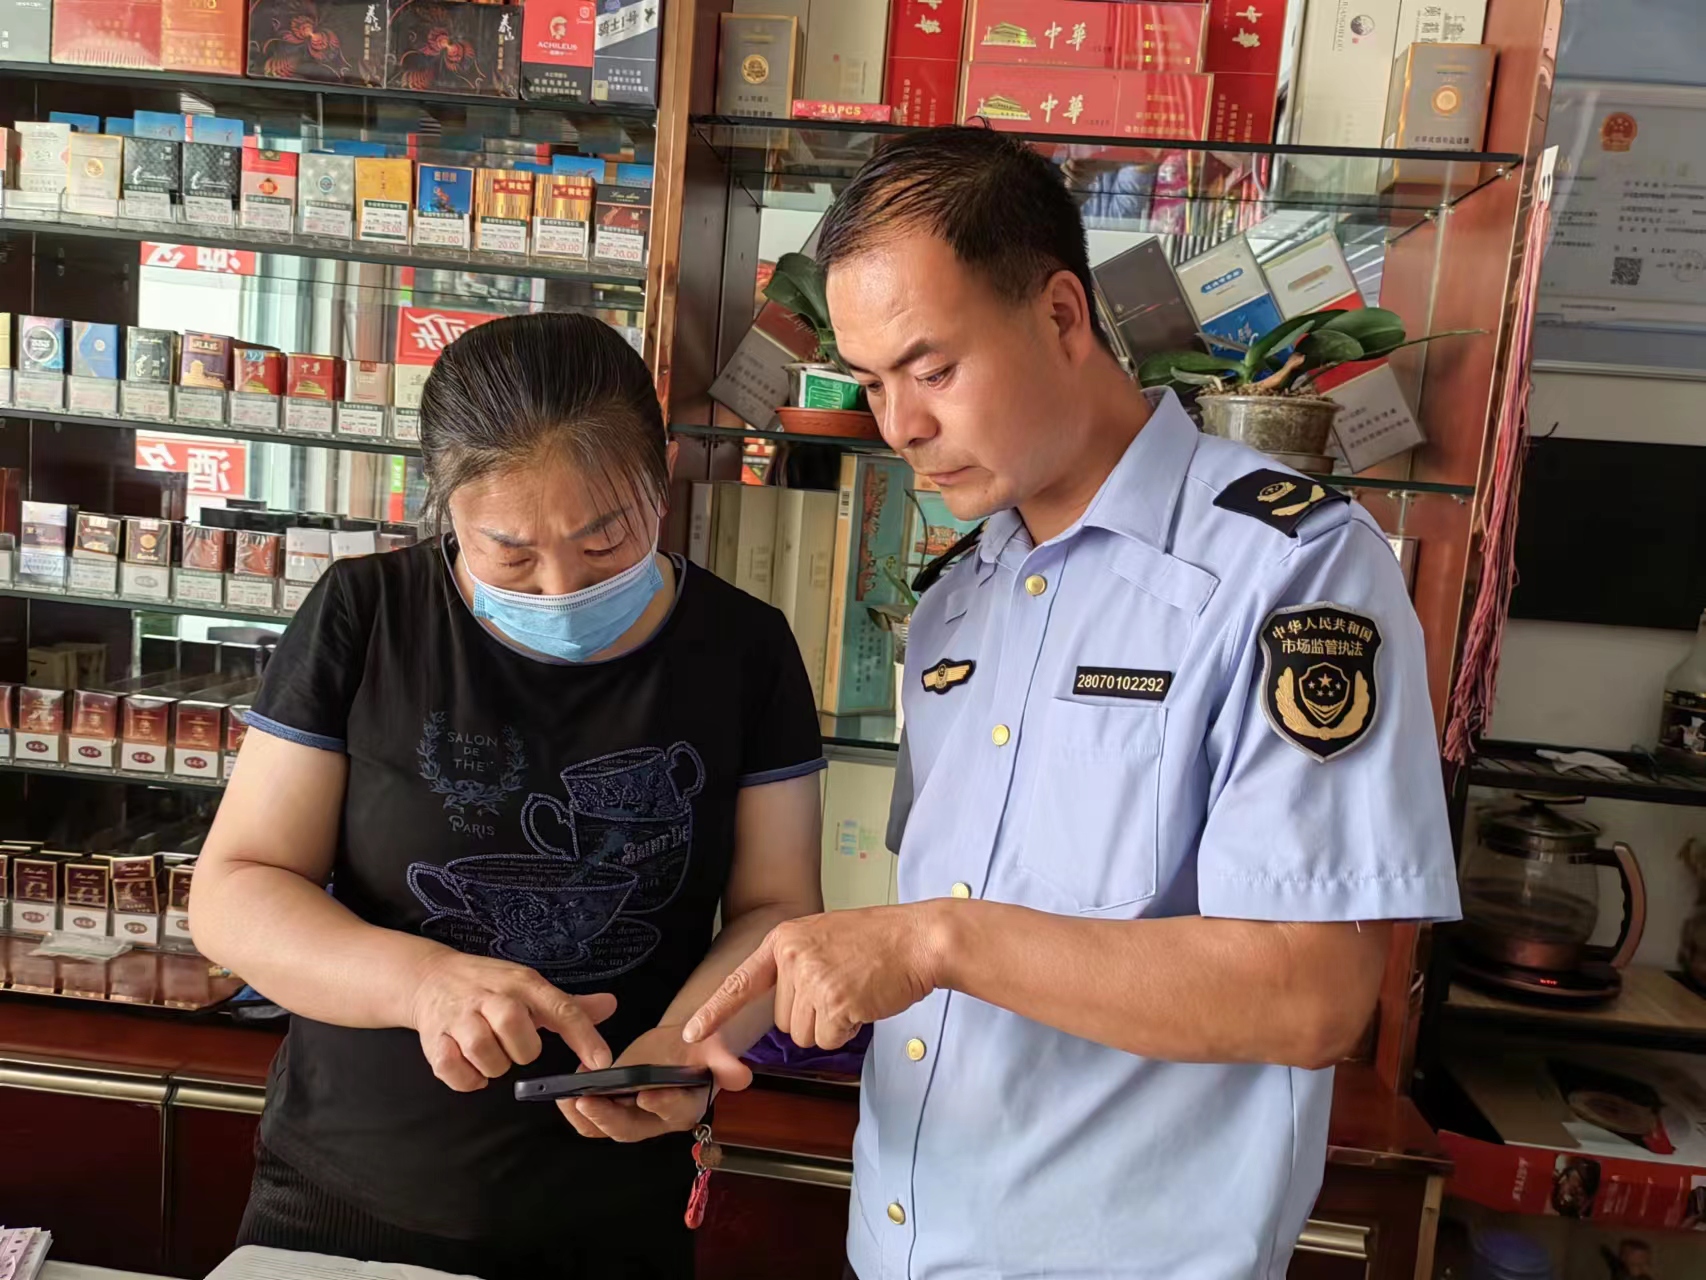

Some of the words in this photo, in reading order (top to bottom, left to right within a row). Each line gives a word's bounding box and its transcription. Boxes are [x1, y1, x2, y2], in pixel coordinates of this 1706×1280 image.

[821, 103, 836, 114] 20
[838, 105, 861, 116] PCS
[498, 241, 519, 250] 20.00
[613, 249, 639, 259] 20.00
[1271, 616, 1374, 643] 中华人民共和国
[1282, 638, 1363, 658] 市场监管执法
[1077, 673, 1164, 693] 28070102292
[447, 731, 498, 747] SALON
[463, 746, 480, 756] DE
